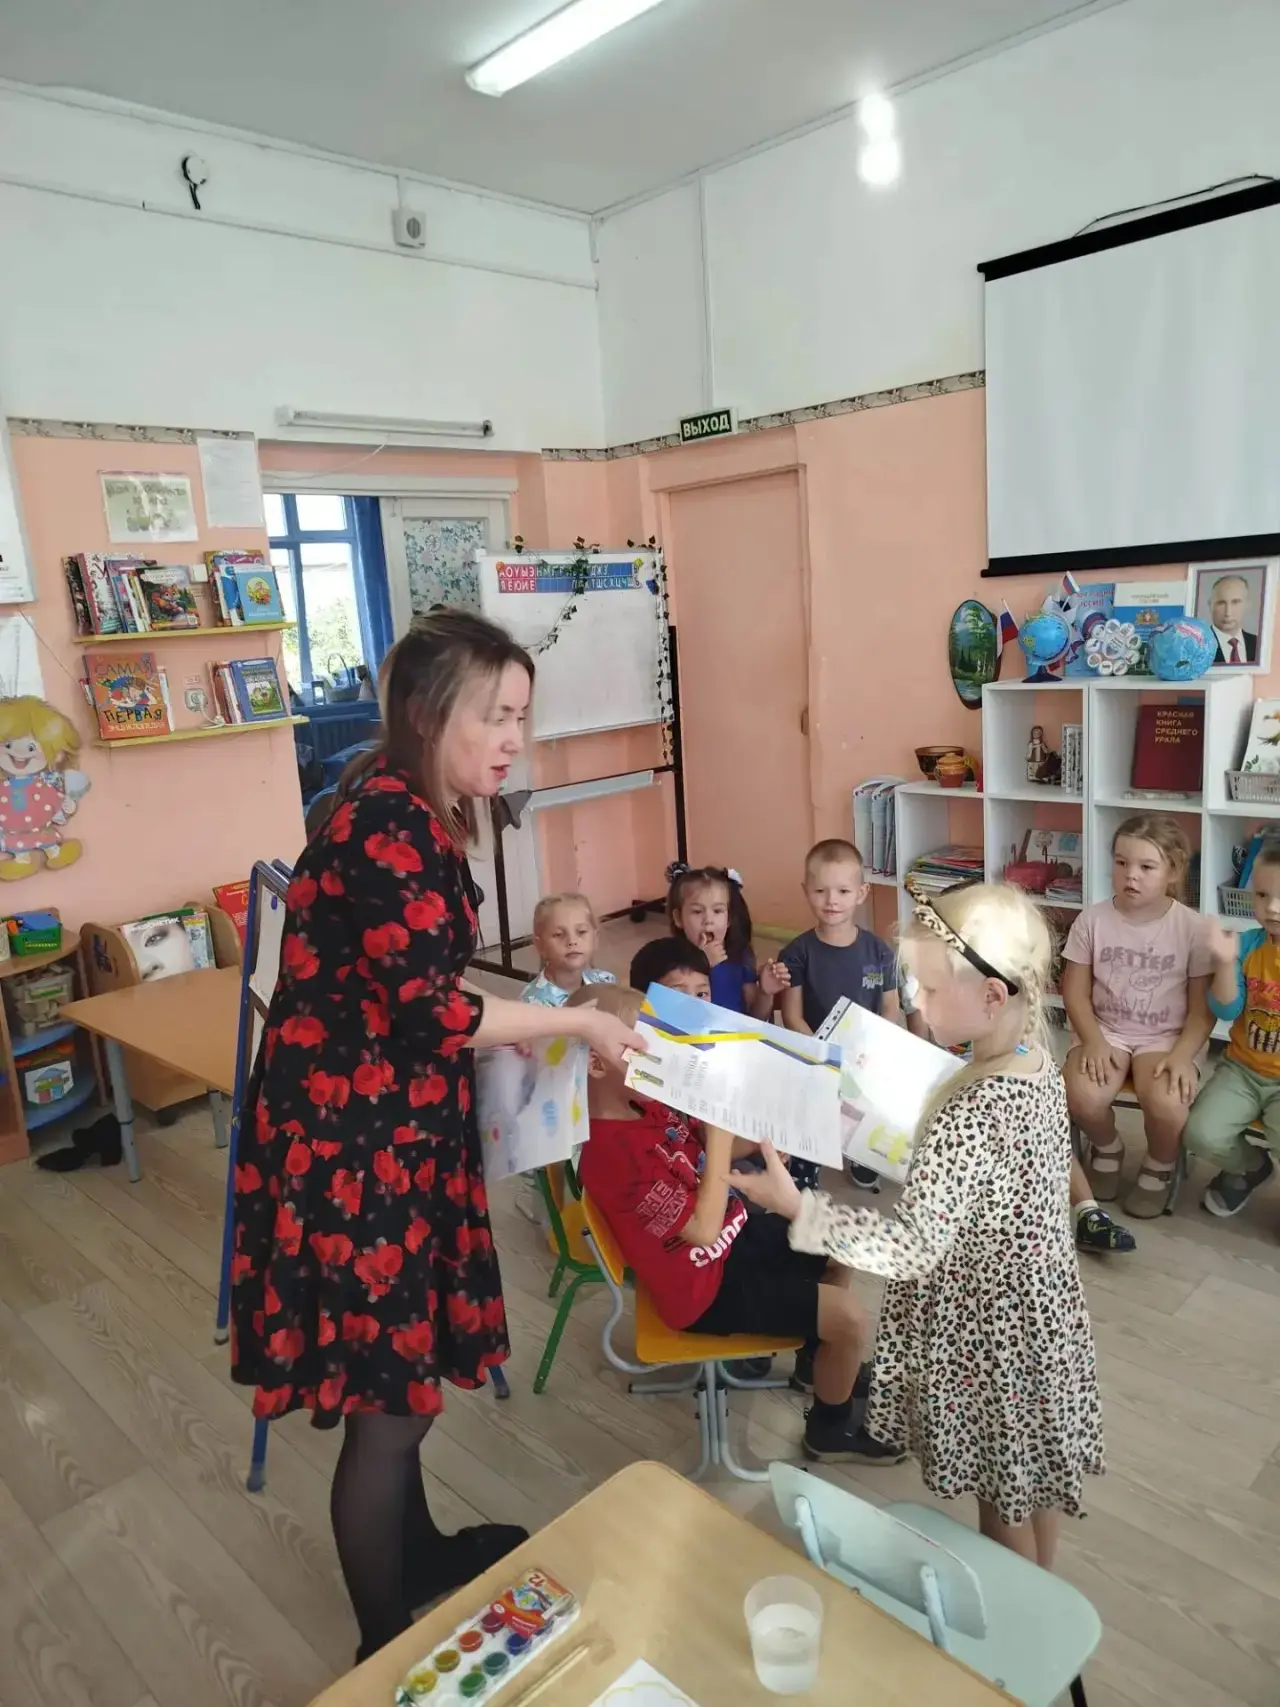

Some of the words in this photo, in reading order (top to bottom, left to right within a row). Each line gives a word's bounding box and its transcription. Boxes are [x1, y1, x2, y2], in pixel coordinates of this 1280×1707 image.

[683, 414, 730, 438] ВЫХОД
[95, 658, 154, 677] САМАЯ
[104, 708, 162, 724] ПЕРВАЯ
[1157, 710, 1195, 718] КРАСНАЯ
[1155, 728, 1198, 736] СРЕДНЕГО
[1099, 946, 1176, 971] BETTER
[1137, 1007, 1170, 1027] YOU
[636, 1179, 674, 1219] THE
